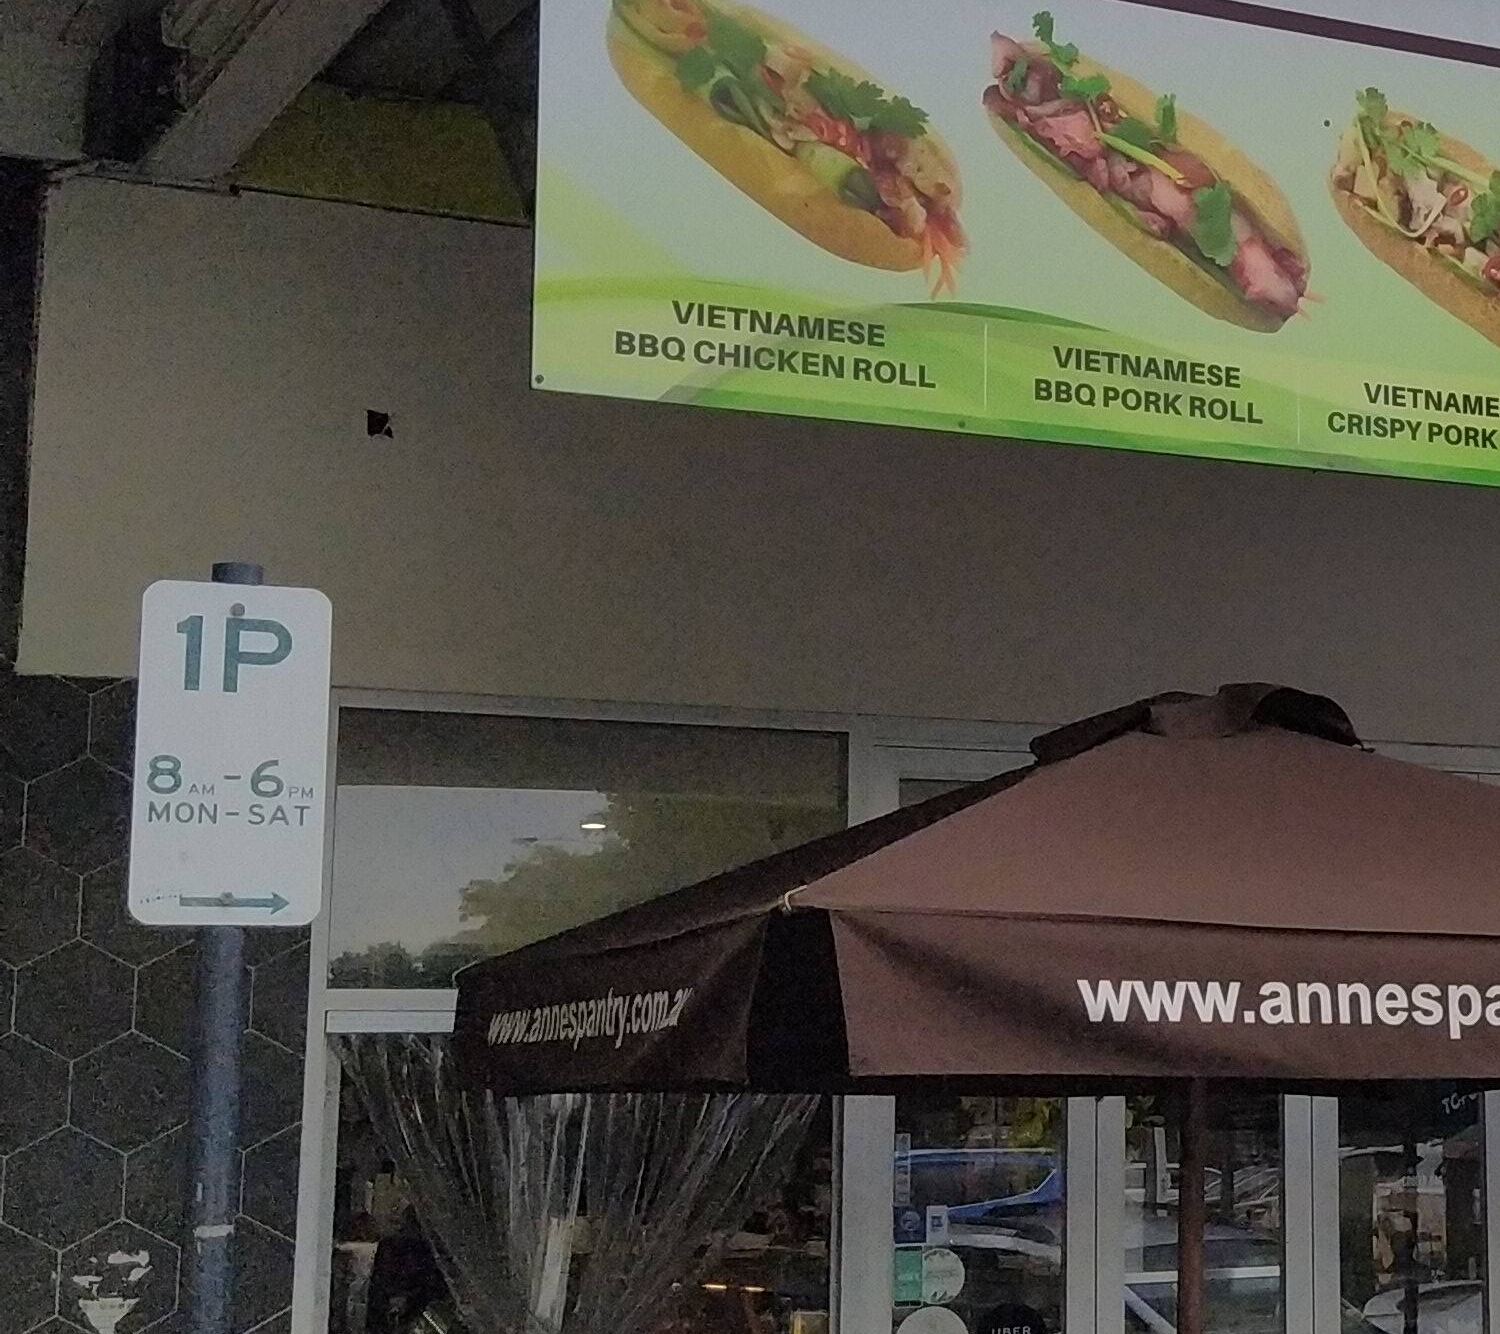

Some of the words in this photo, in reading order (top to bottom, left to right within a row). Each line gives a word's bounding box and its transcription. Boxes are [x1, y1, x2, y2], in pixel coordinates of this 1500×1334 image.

[671, 299, 886, 348] VIETNAMESE
[614, 329, 686, 361] BBQ
[692, 338, 845, 379] CHICKEN
[851, 357, 937, 389] ROLL
[1052, 344, 1242, 389] VIETNAMESE
[1033, 377, 1096, 407] BBQ
[1101, 384, 1183, 417] PORK
[1188, 395, 1264, 425] ROLL
[1327, 410, 1423, 445] CRISPY
[1427, 422, 1499, 452] PORK
[176, 615, 293, 693] 1P
